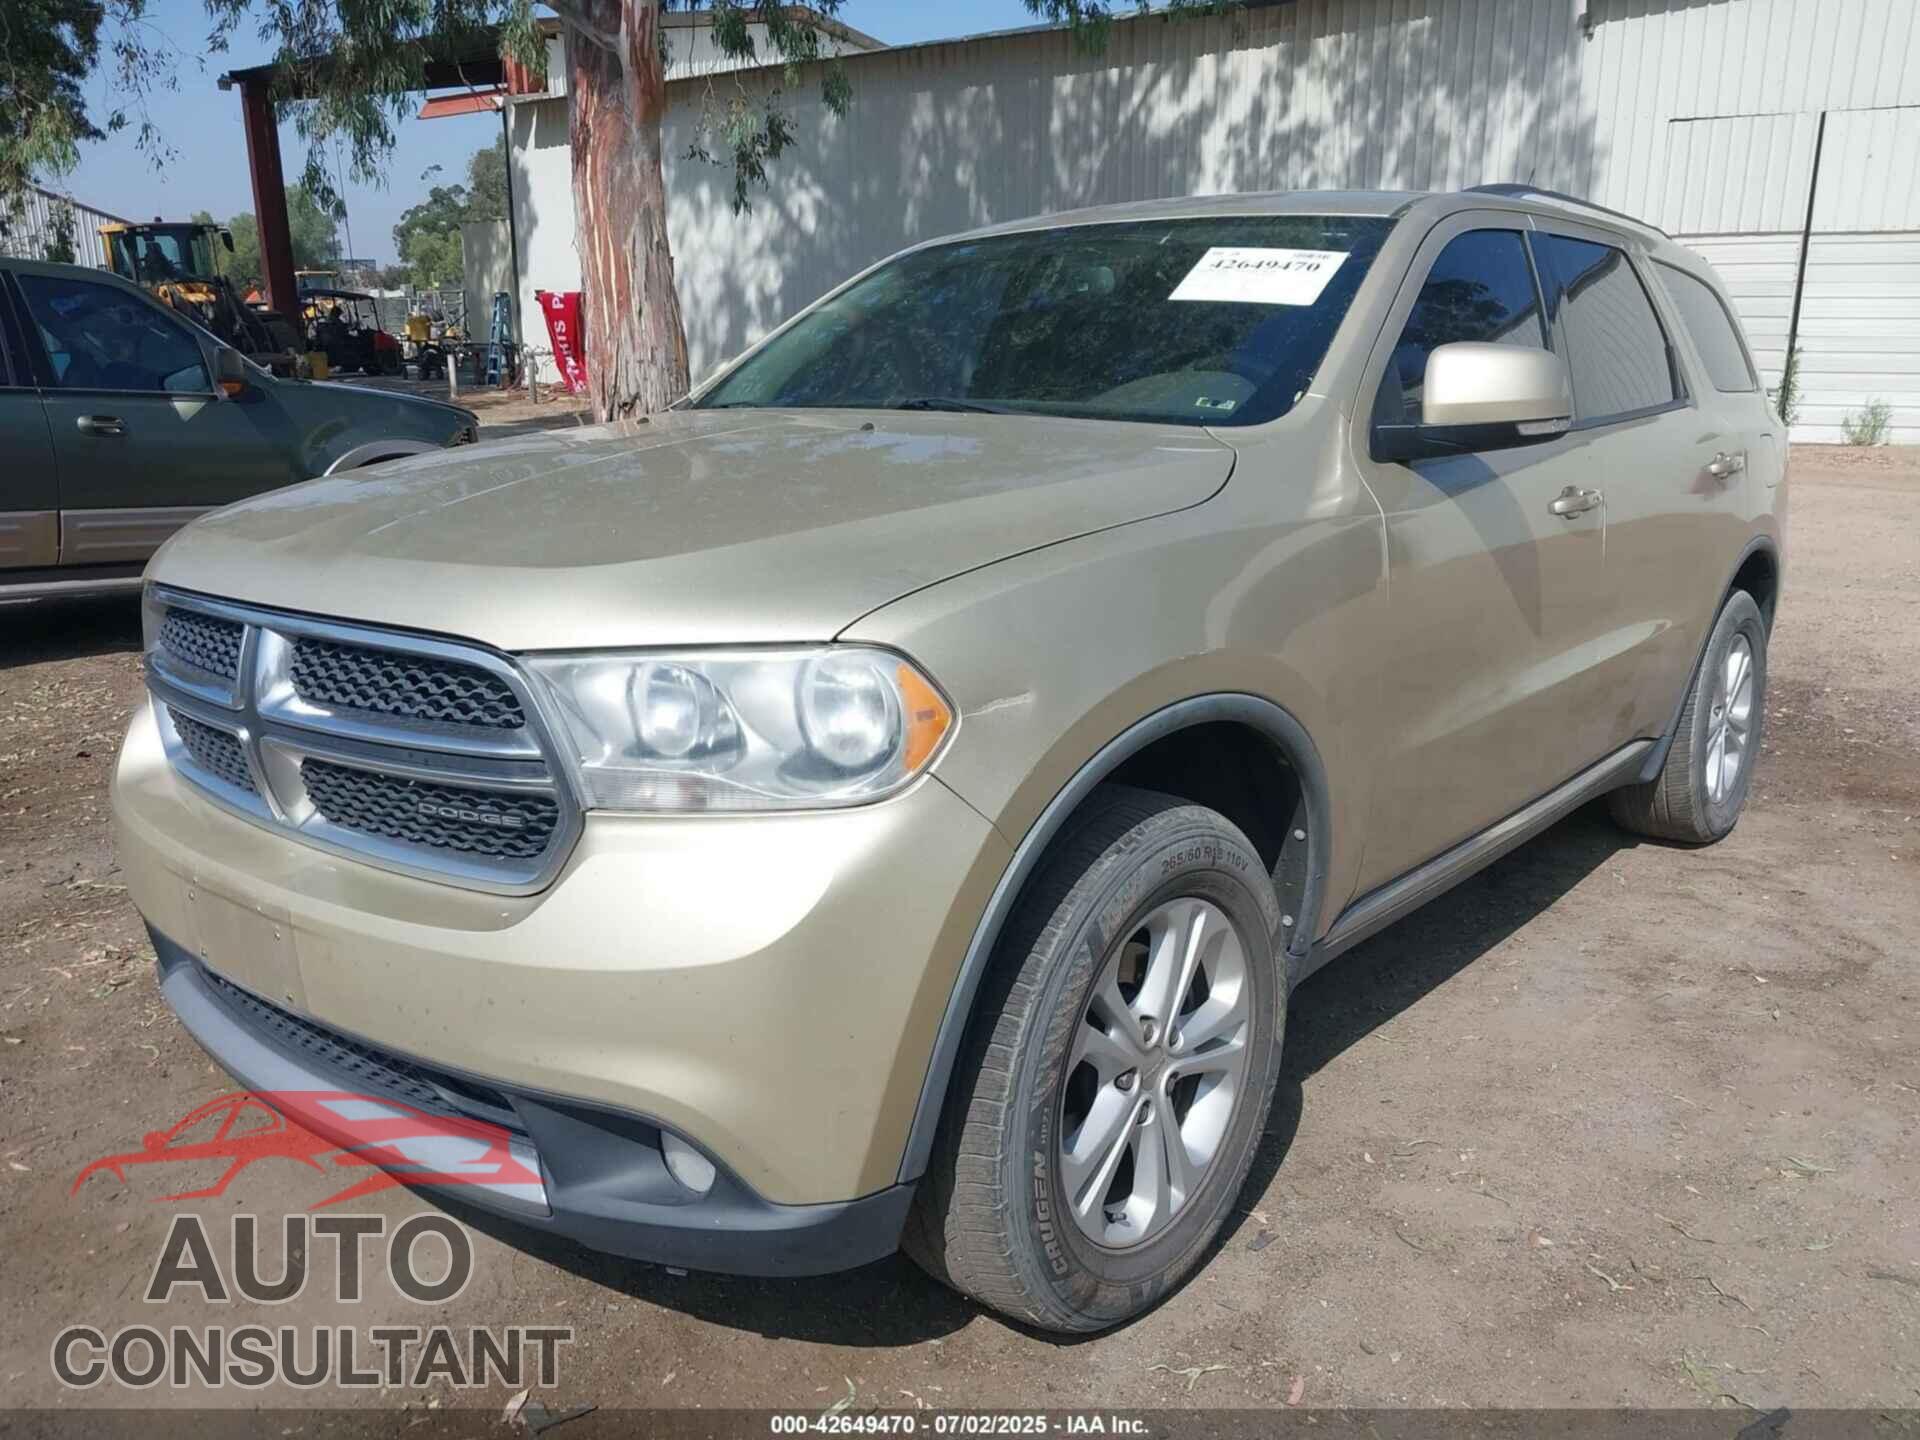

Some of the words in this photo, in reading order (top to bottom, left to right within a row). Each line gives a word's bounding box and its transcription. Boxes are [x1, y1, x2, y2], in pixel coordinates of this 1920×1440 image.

[1208, 259, 1322, 272] 42649470
[417, 802, 523, 828] DODGE
[1161, 847, 1201, 875] 265/60
[1034, 1151, 1069, 1275] CRUGEN
